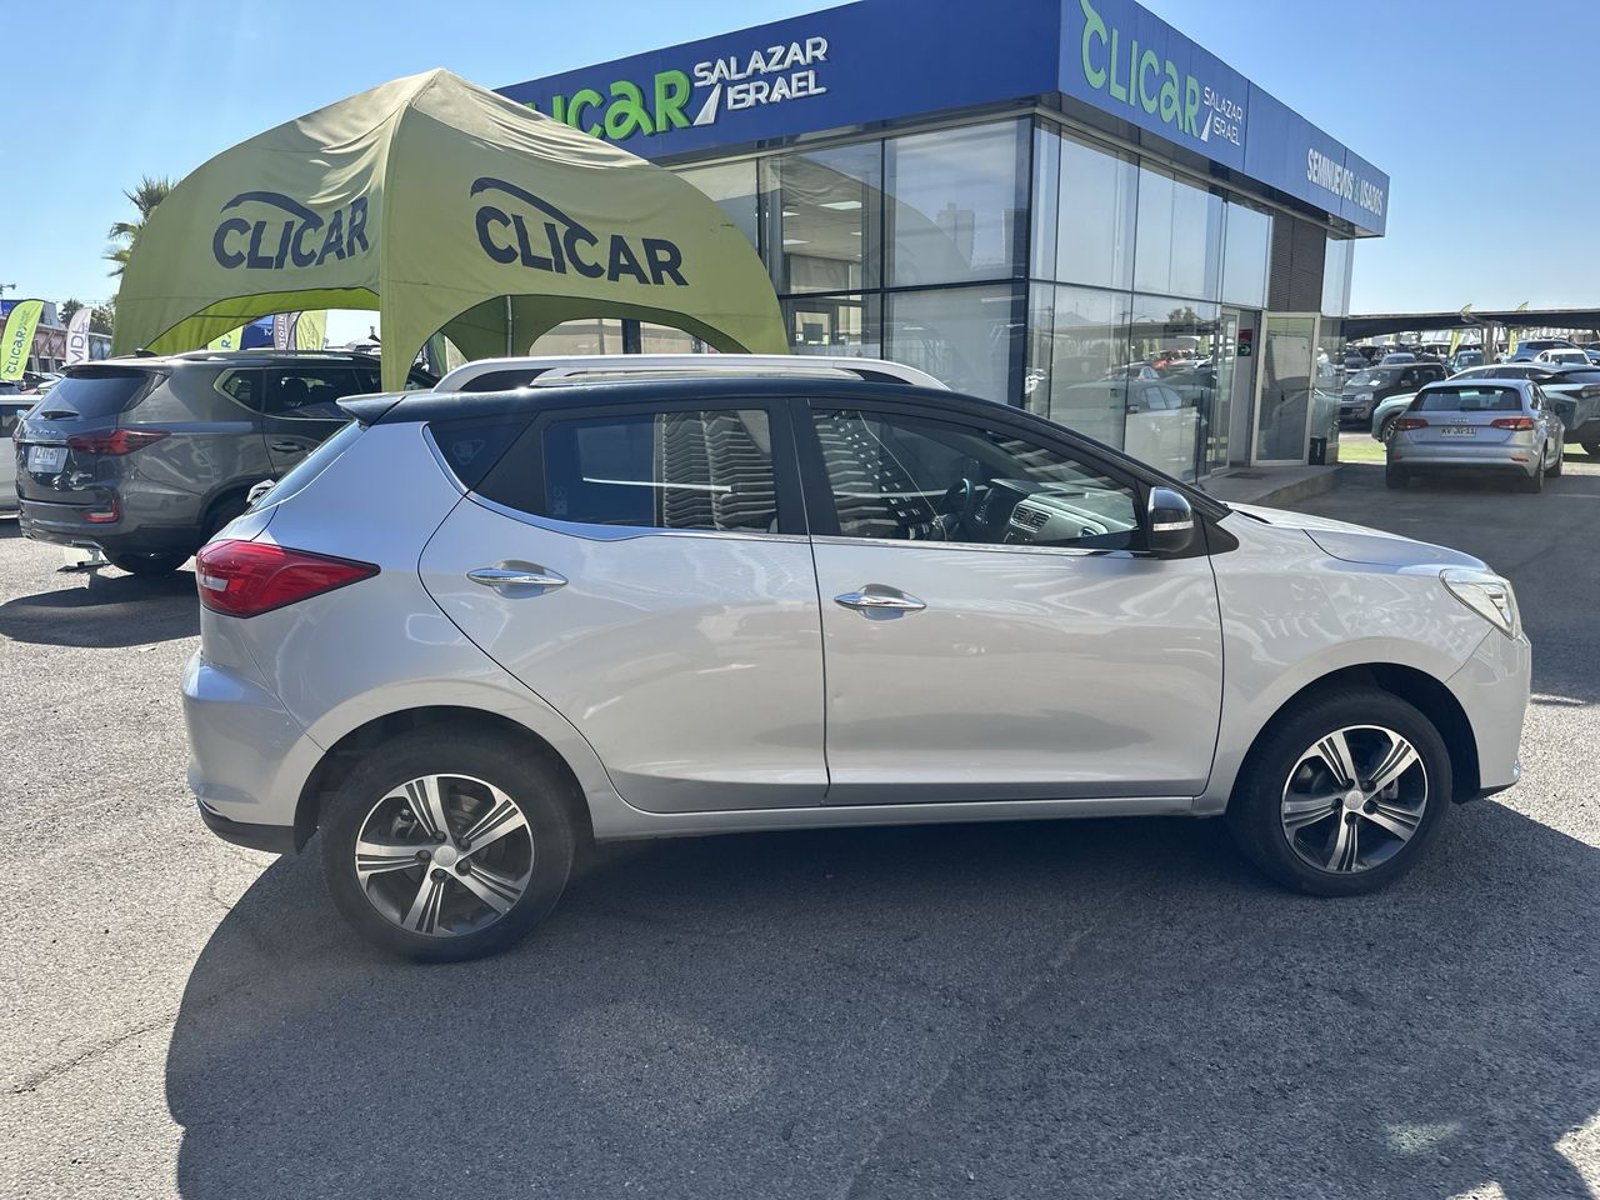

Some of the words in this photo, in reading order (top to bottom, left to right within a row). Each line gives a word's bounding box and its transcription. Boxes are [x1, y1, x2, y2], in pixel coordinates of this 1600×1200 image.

[693, 36, 829, 88] SALAZAR
[727, 69, 828, 111] ISRAEL
[1203, 86, 1243, 126] SALAZAR
[1213, 116, 1241, 146] ISRAEL
[213, 196, 370, 270] CLICAR
[474, 205, 690, 286] CLICAR
